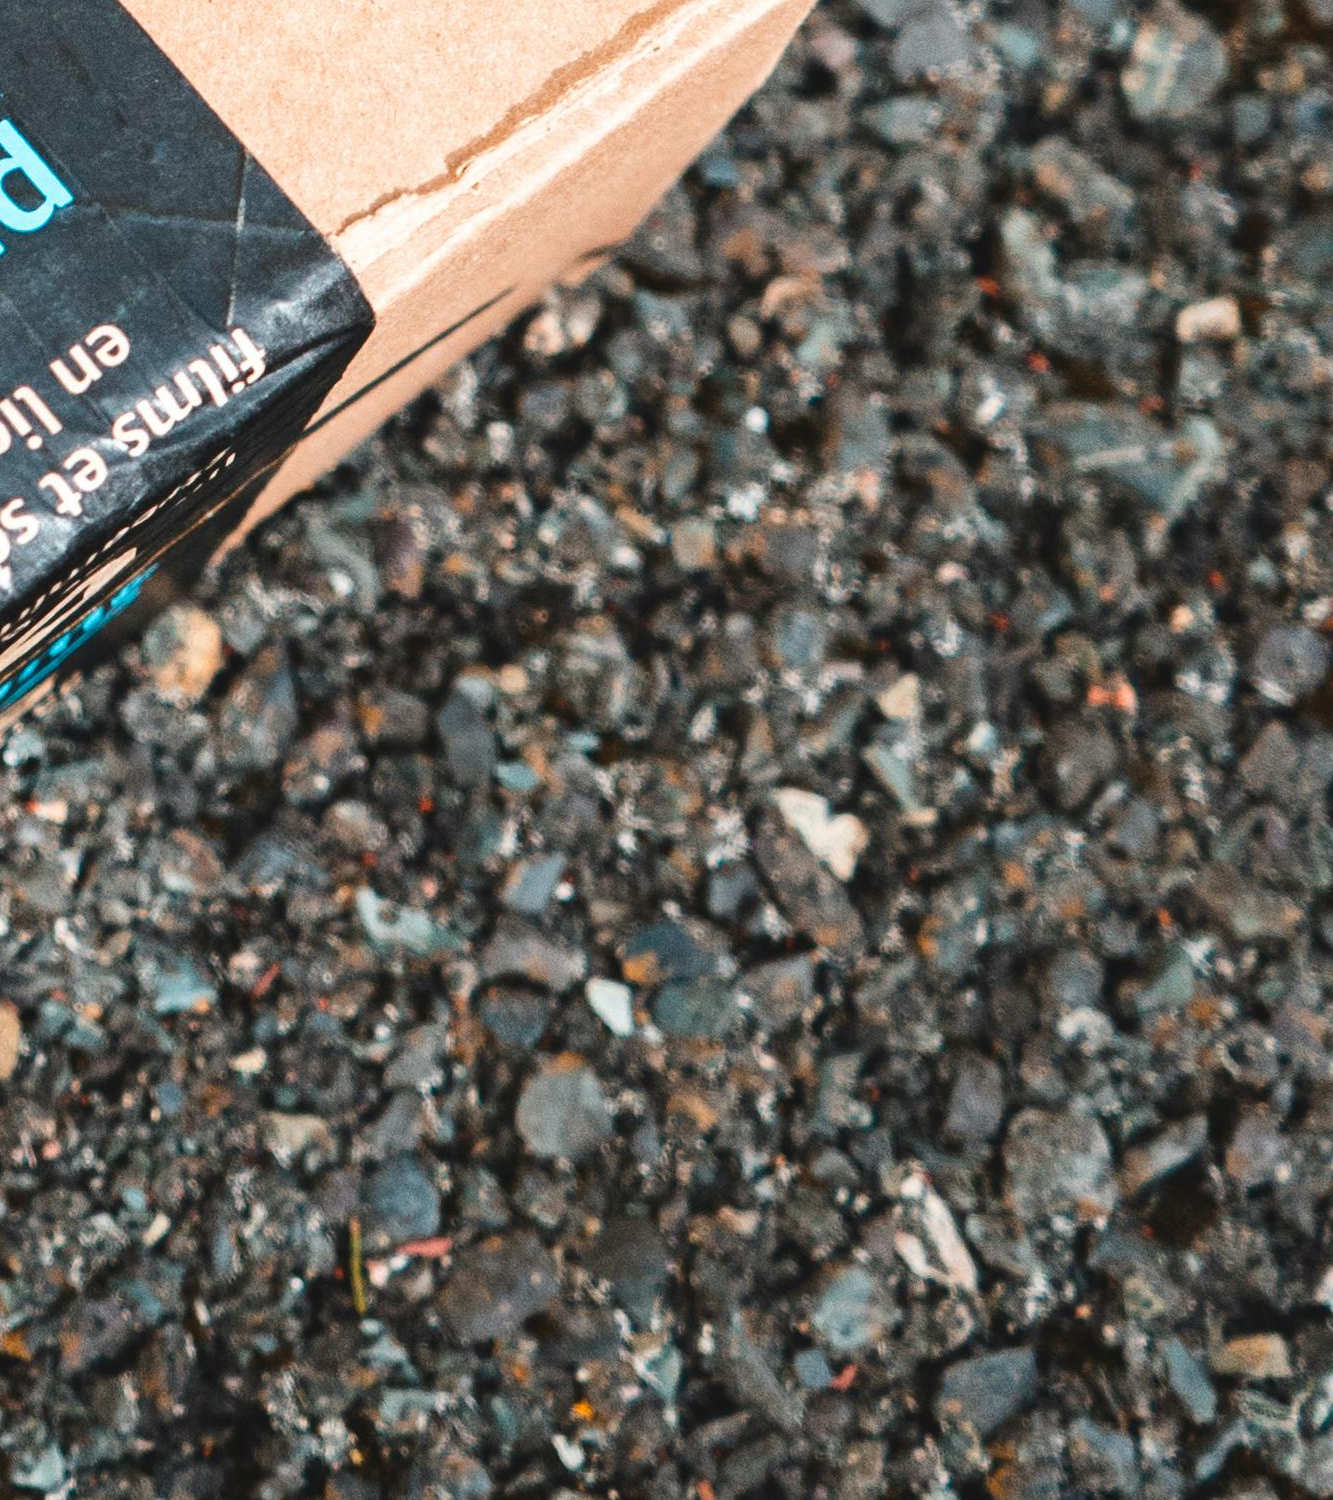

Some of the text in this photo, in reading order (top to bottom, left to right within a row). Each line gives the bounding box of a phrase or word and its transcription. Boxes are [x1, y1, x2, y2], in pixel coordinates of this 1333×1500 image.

[50, 325, 130, 394] en
[109, 329, 265, 458] films
[39, 446, 108, 517] et
